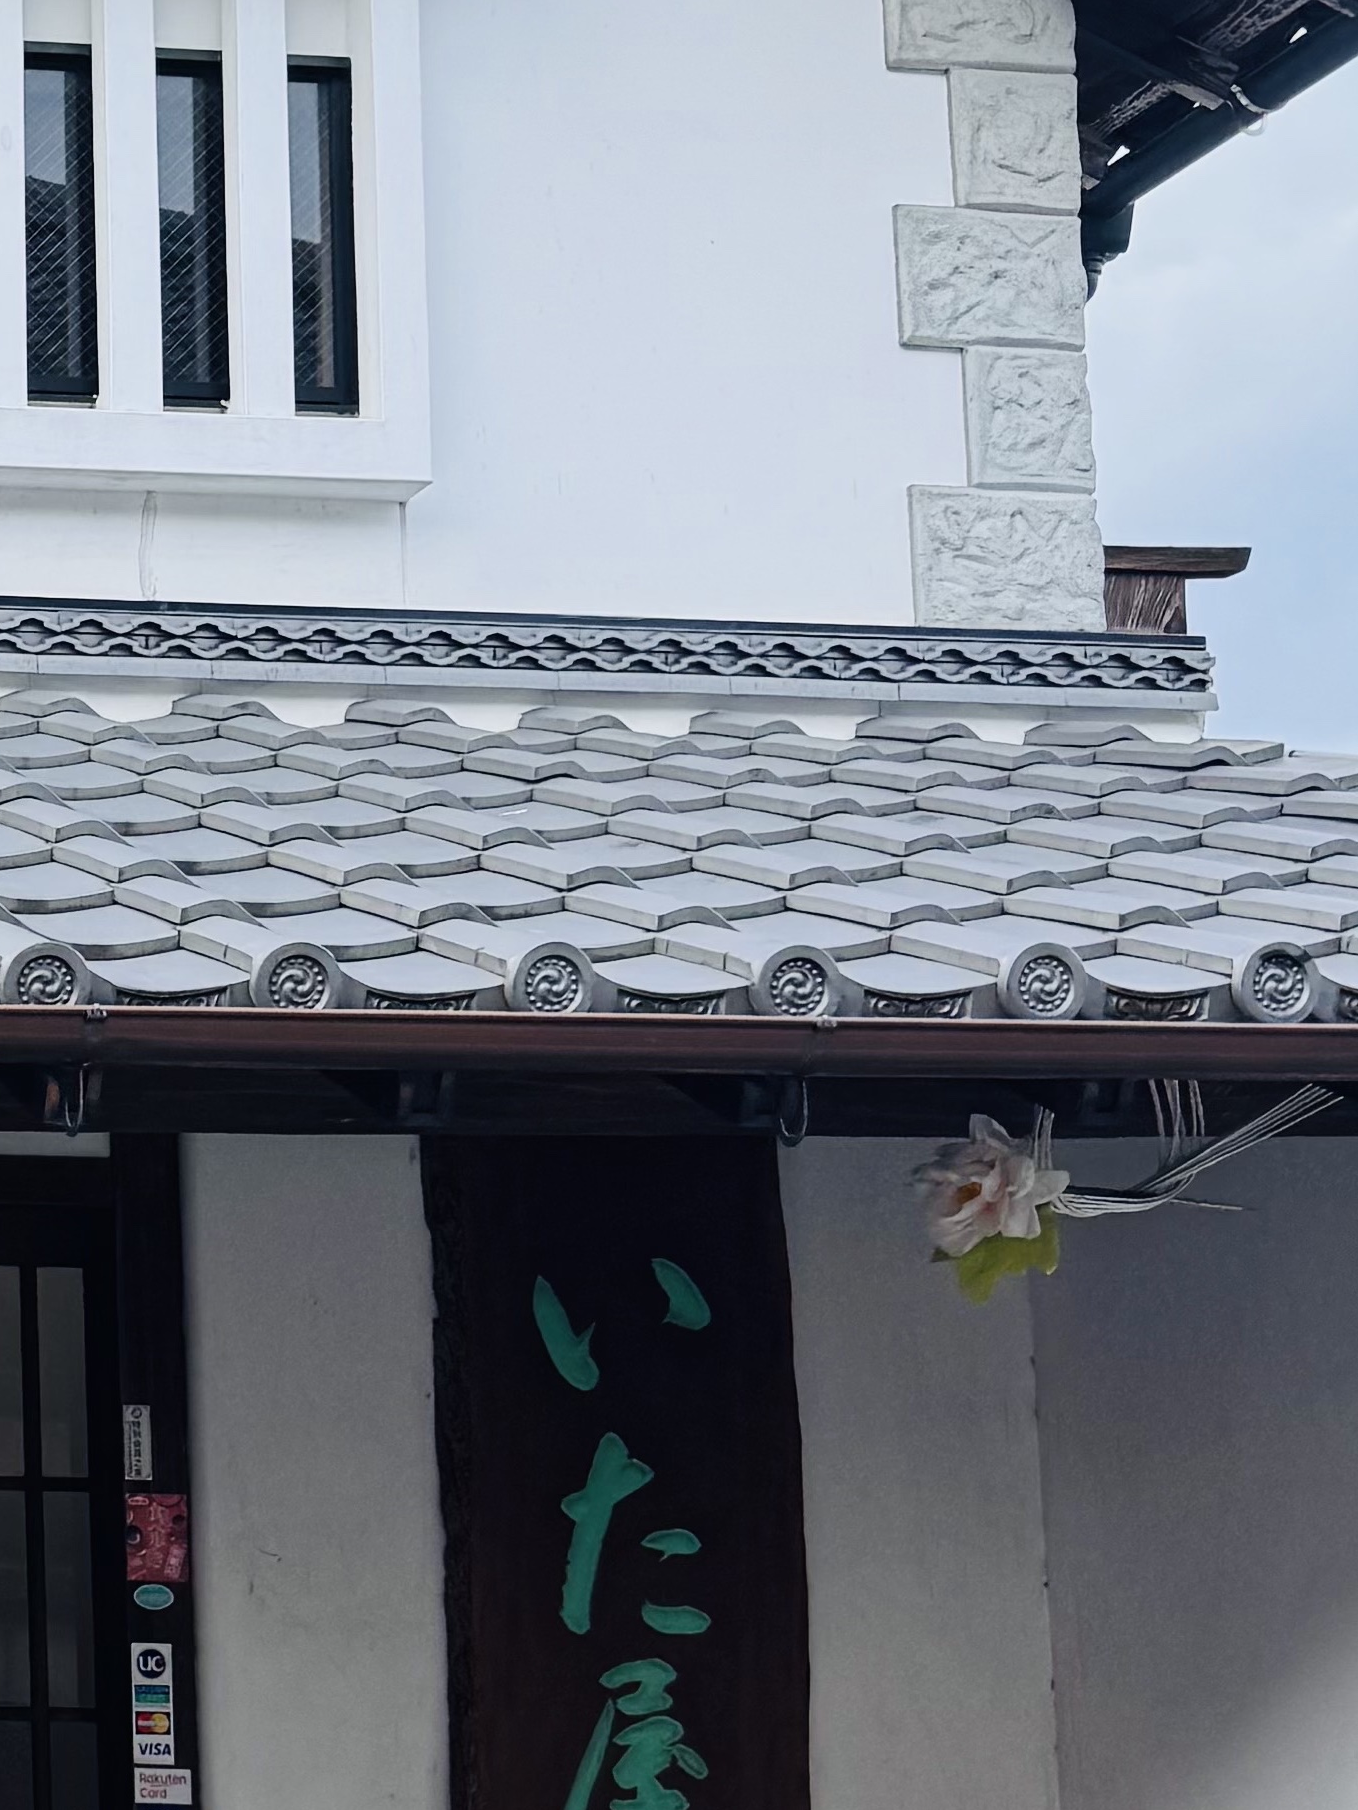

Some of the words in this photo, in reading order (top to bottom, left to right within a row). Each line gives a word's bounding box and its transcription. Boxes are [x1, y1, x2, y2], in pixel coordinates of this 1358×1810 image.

[139, 1655, 165, 1672] UC
[138, 1743, 172, 1756] VISA
[139, 1773, 187, 1787] Rakuten
[139, 1788, 168, 1800] Card
